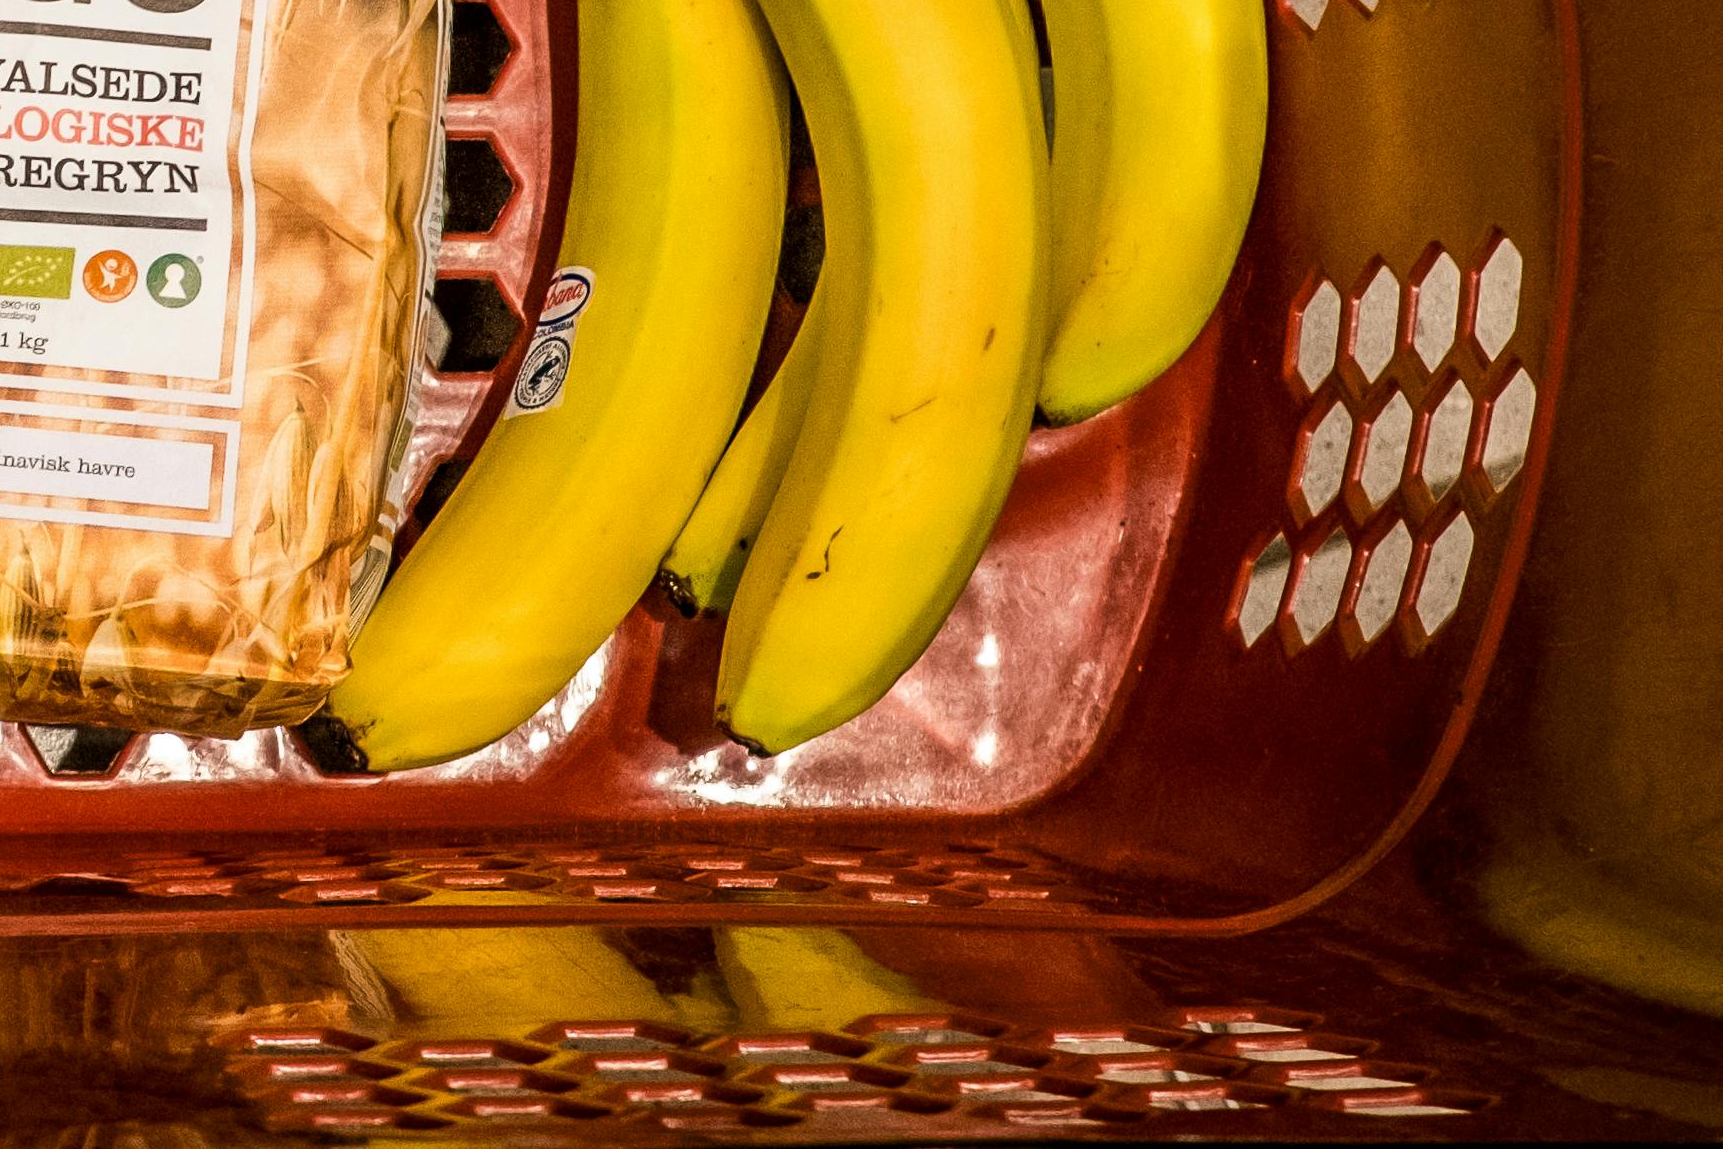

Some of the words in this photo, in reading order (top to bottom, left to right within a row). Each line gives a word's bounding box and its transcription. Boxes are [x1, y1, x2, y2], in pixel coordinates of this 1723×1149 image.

[0, 332, 8, 348] 1
[18, 331, 49, 355] kg
[78, 456, 136, 479] havre
